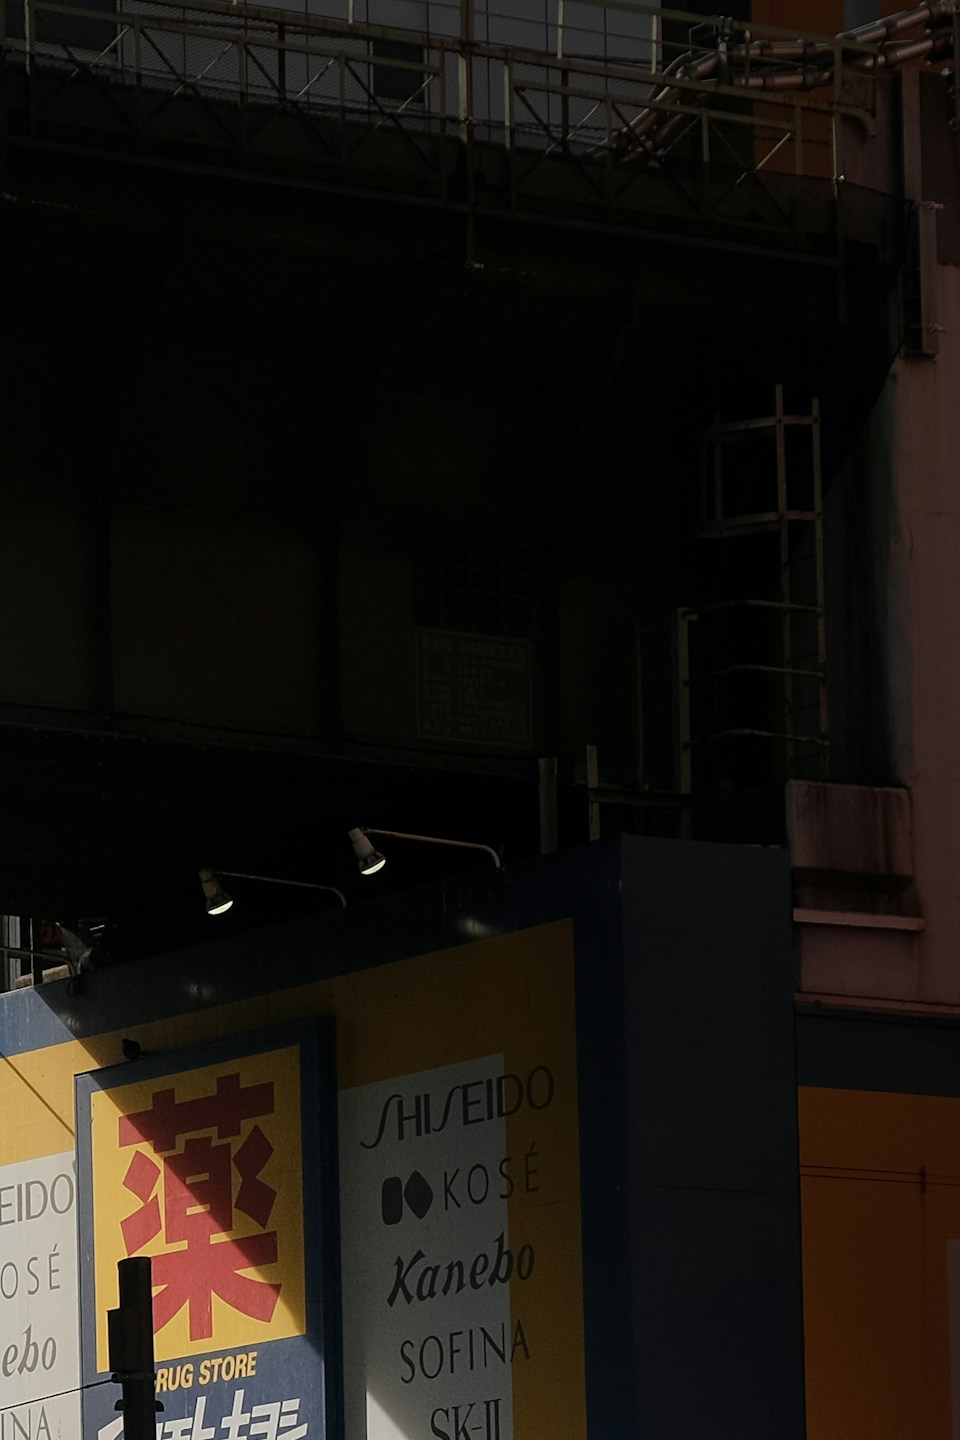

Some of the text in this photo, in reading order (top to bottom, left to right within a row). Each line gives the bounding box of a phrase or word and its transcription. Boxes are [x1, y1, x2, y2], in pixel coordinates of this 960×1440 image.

[360, 1065, 554, 1149] SHISEIDO
[118, 1072, 283, 1342] 薬
[443, 1142, 539, 1211] KOSÉ
[386, 1231, 535, 1308] Kanebo
[153, 1351, 258, 1394] RUG STORE
[400, 1318, 530, 1384] SOFINA
